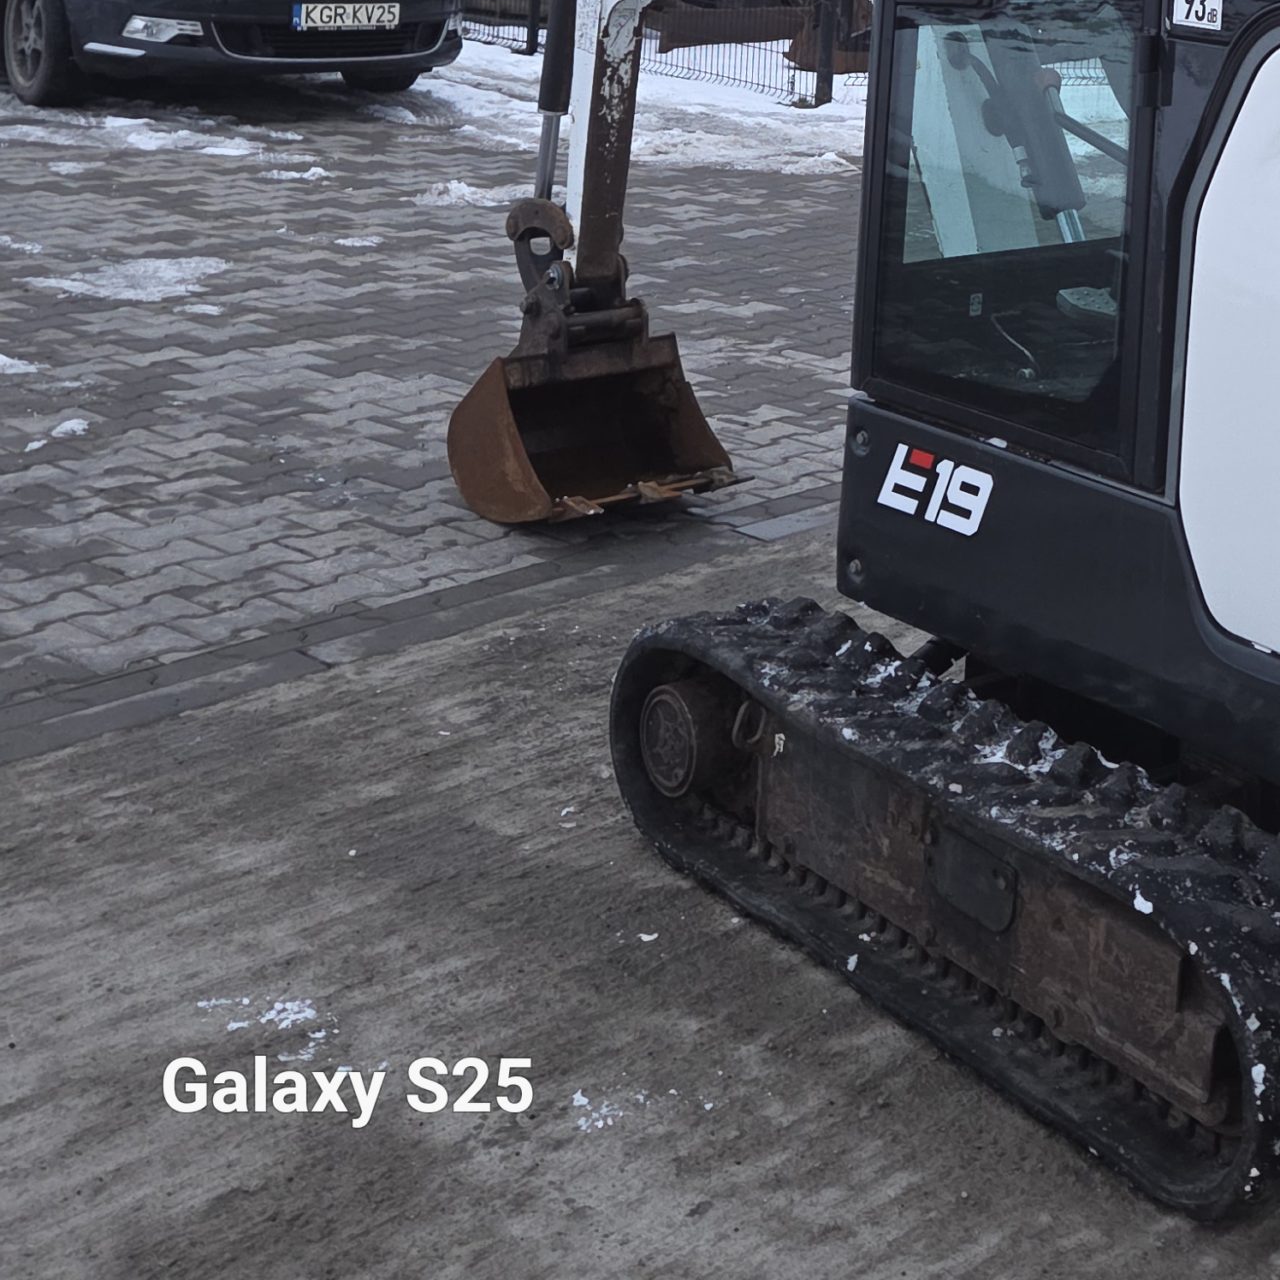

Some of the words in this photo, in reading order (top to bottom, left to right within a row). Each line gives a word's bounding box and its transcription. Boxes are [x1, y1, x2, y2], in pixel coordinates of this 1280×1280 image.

[305, 4, 347, 25] KGR
[352, 4, 396, 24] KV25
[876, 442, 994, 537] E19
